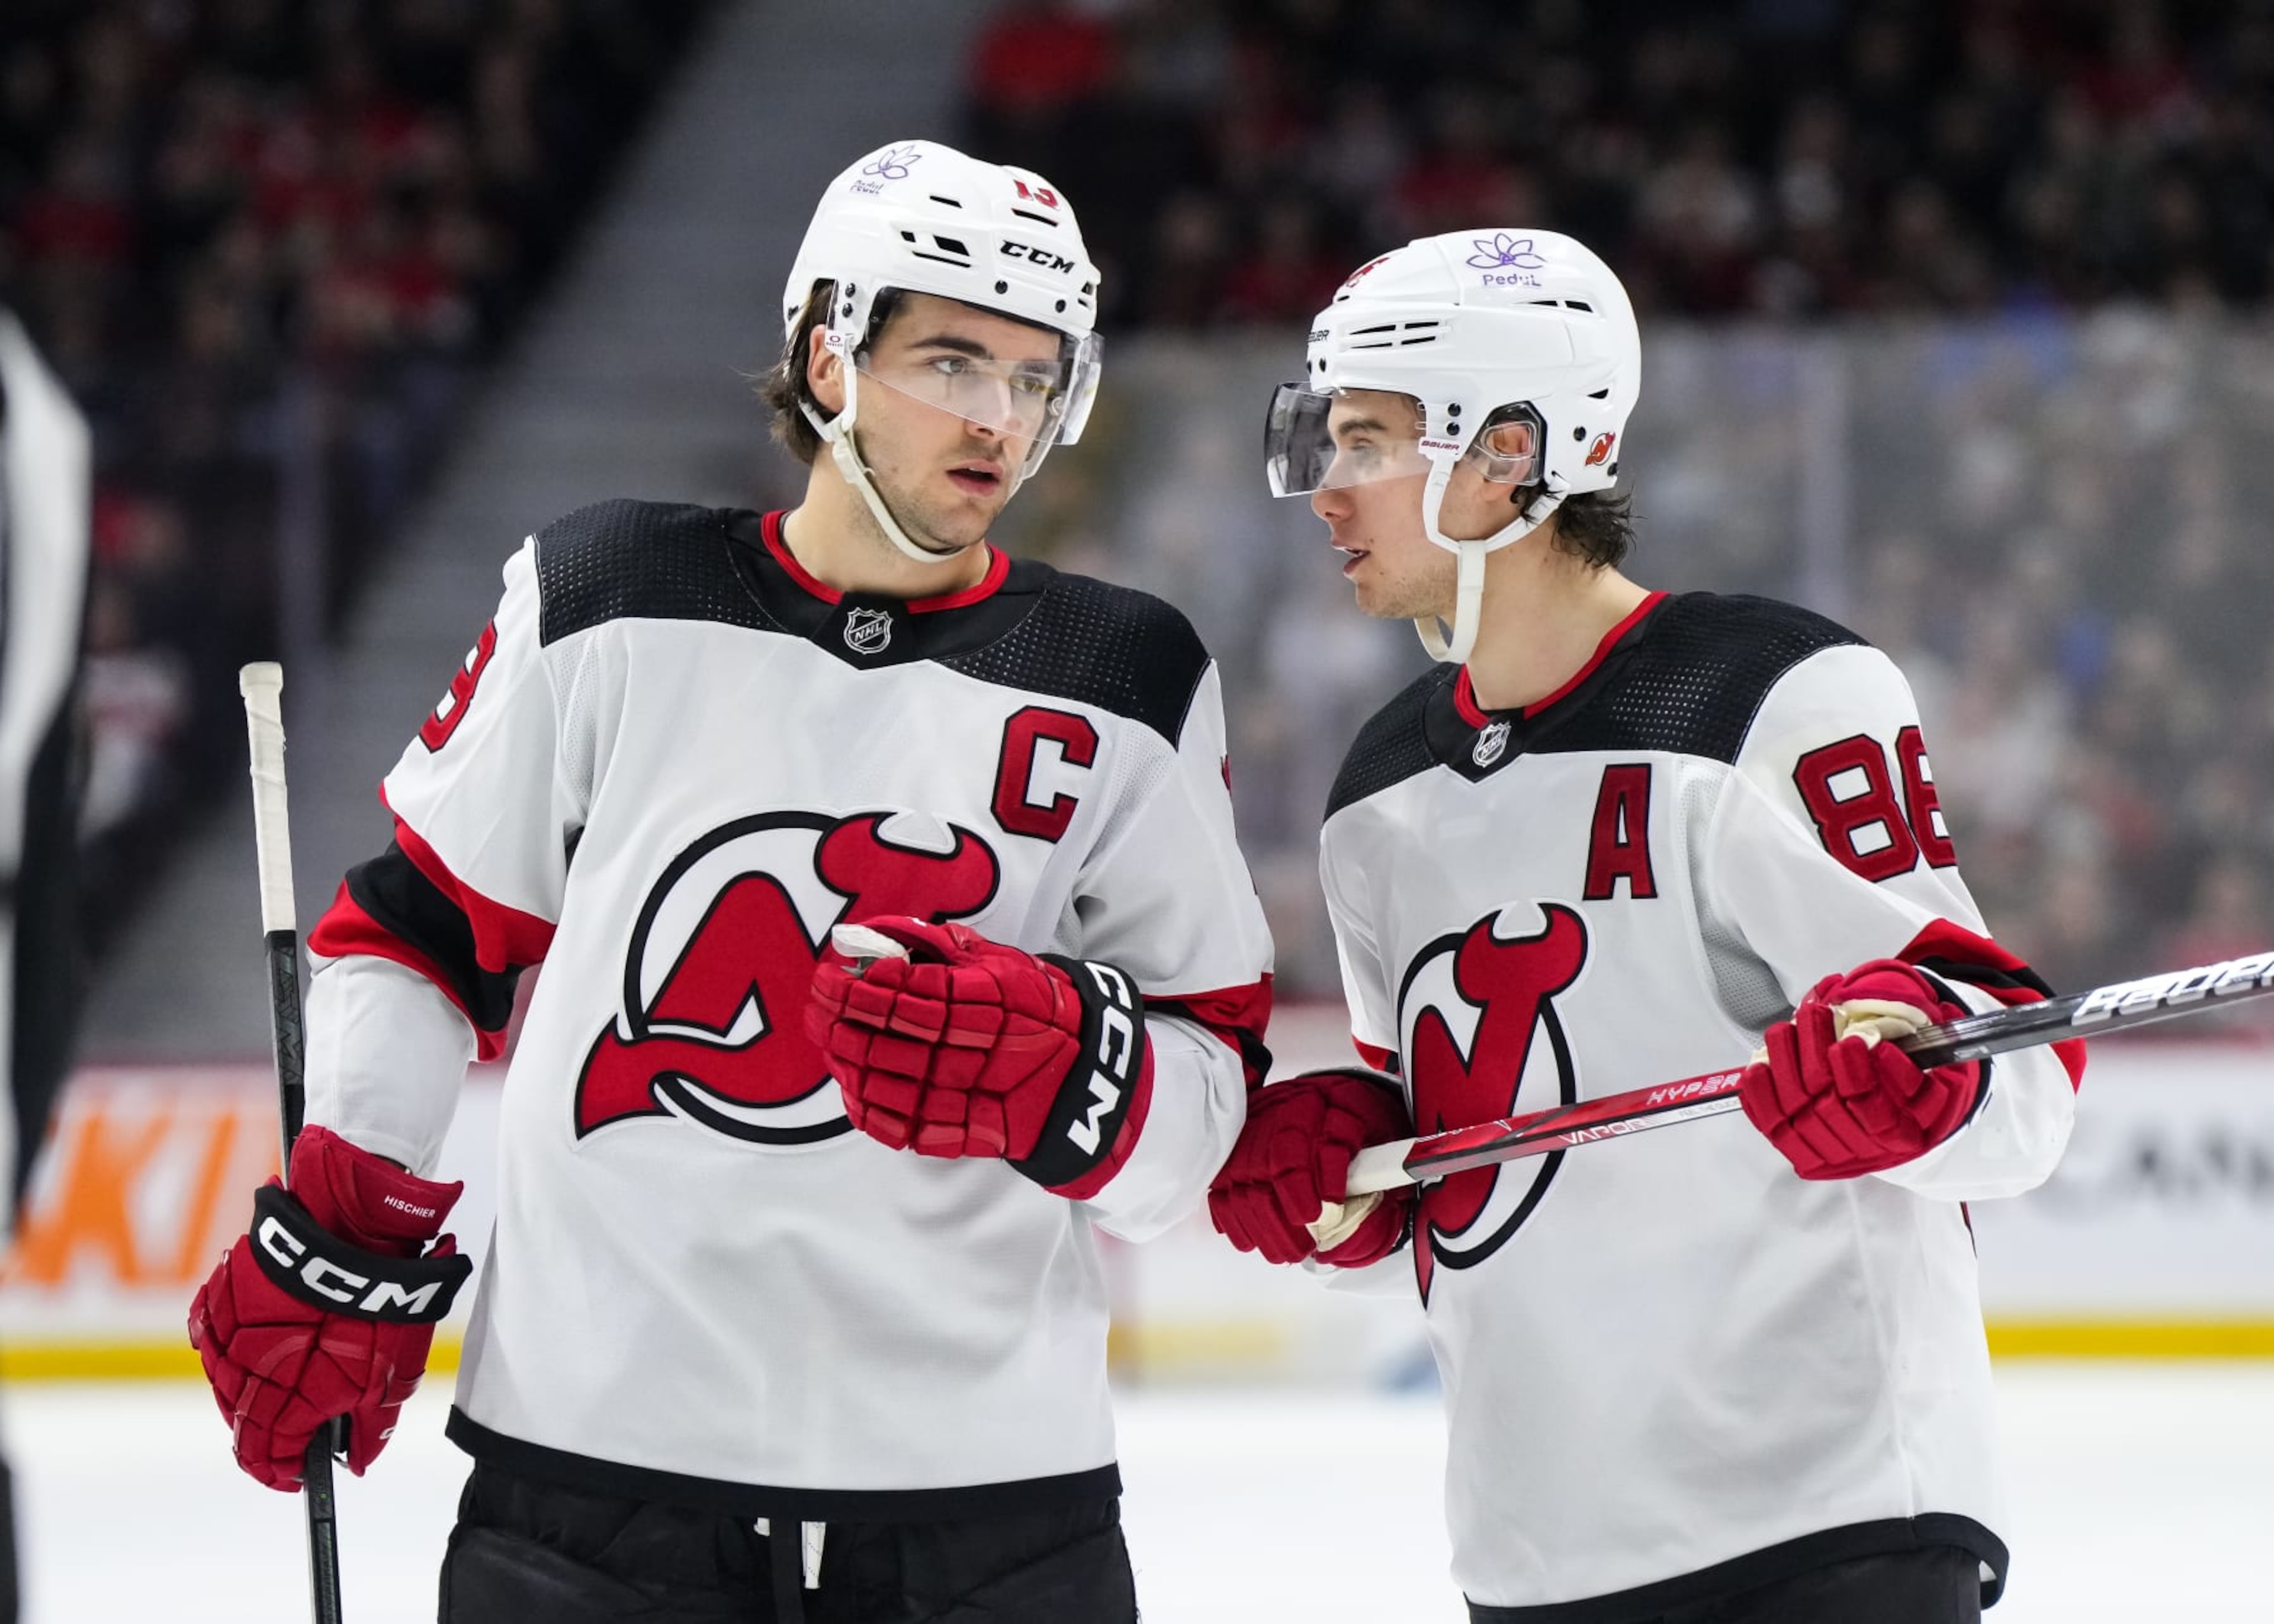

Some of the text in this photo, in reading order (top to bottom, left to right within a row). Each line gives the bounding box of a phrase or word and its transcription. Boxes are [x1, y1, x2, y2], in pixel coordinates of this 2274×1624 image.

[1000, 239, 1075, 274] CCM
[854, 622, 883, 642] NHL
[990, 705, 1099, 844] C
[1582, 763, 1658, 901] A
[1066, 961, 1133, 1156] CCM
[1559, 1117, 1647, 1145] VAPOR
[384, 1195, 436, 1218] HISCHIER
[258, 1215, 443, 1315] CCM
